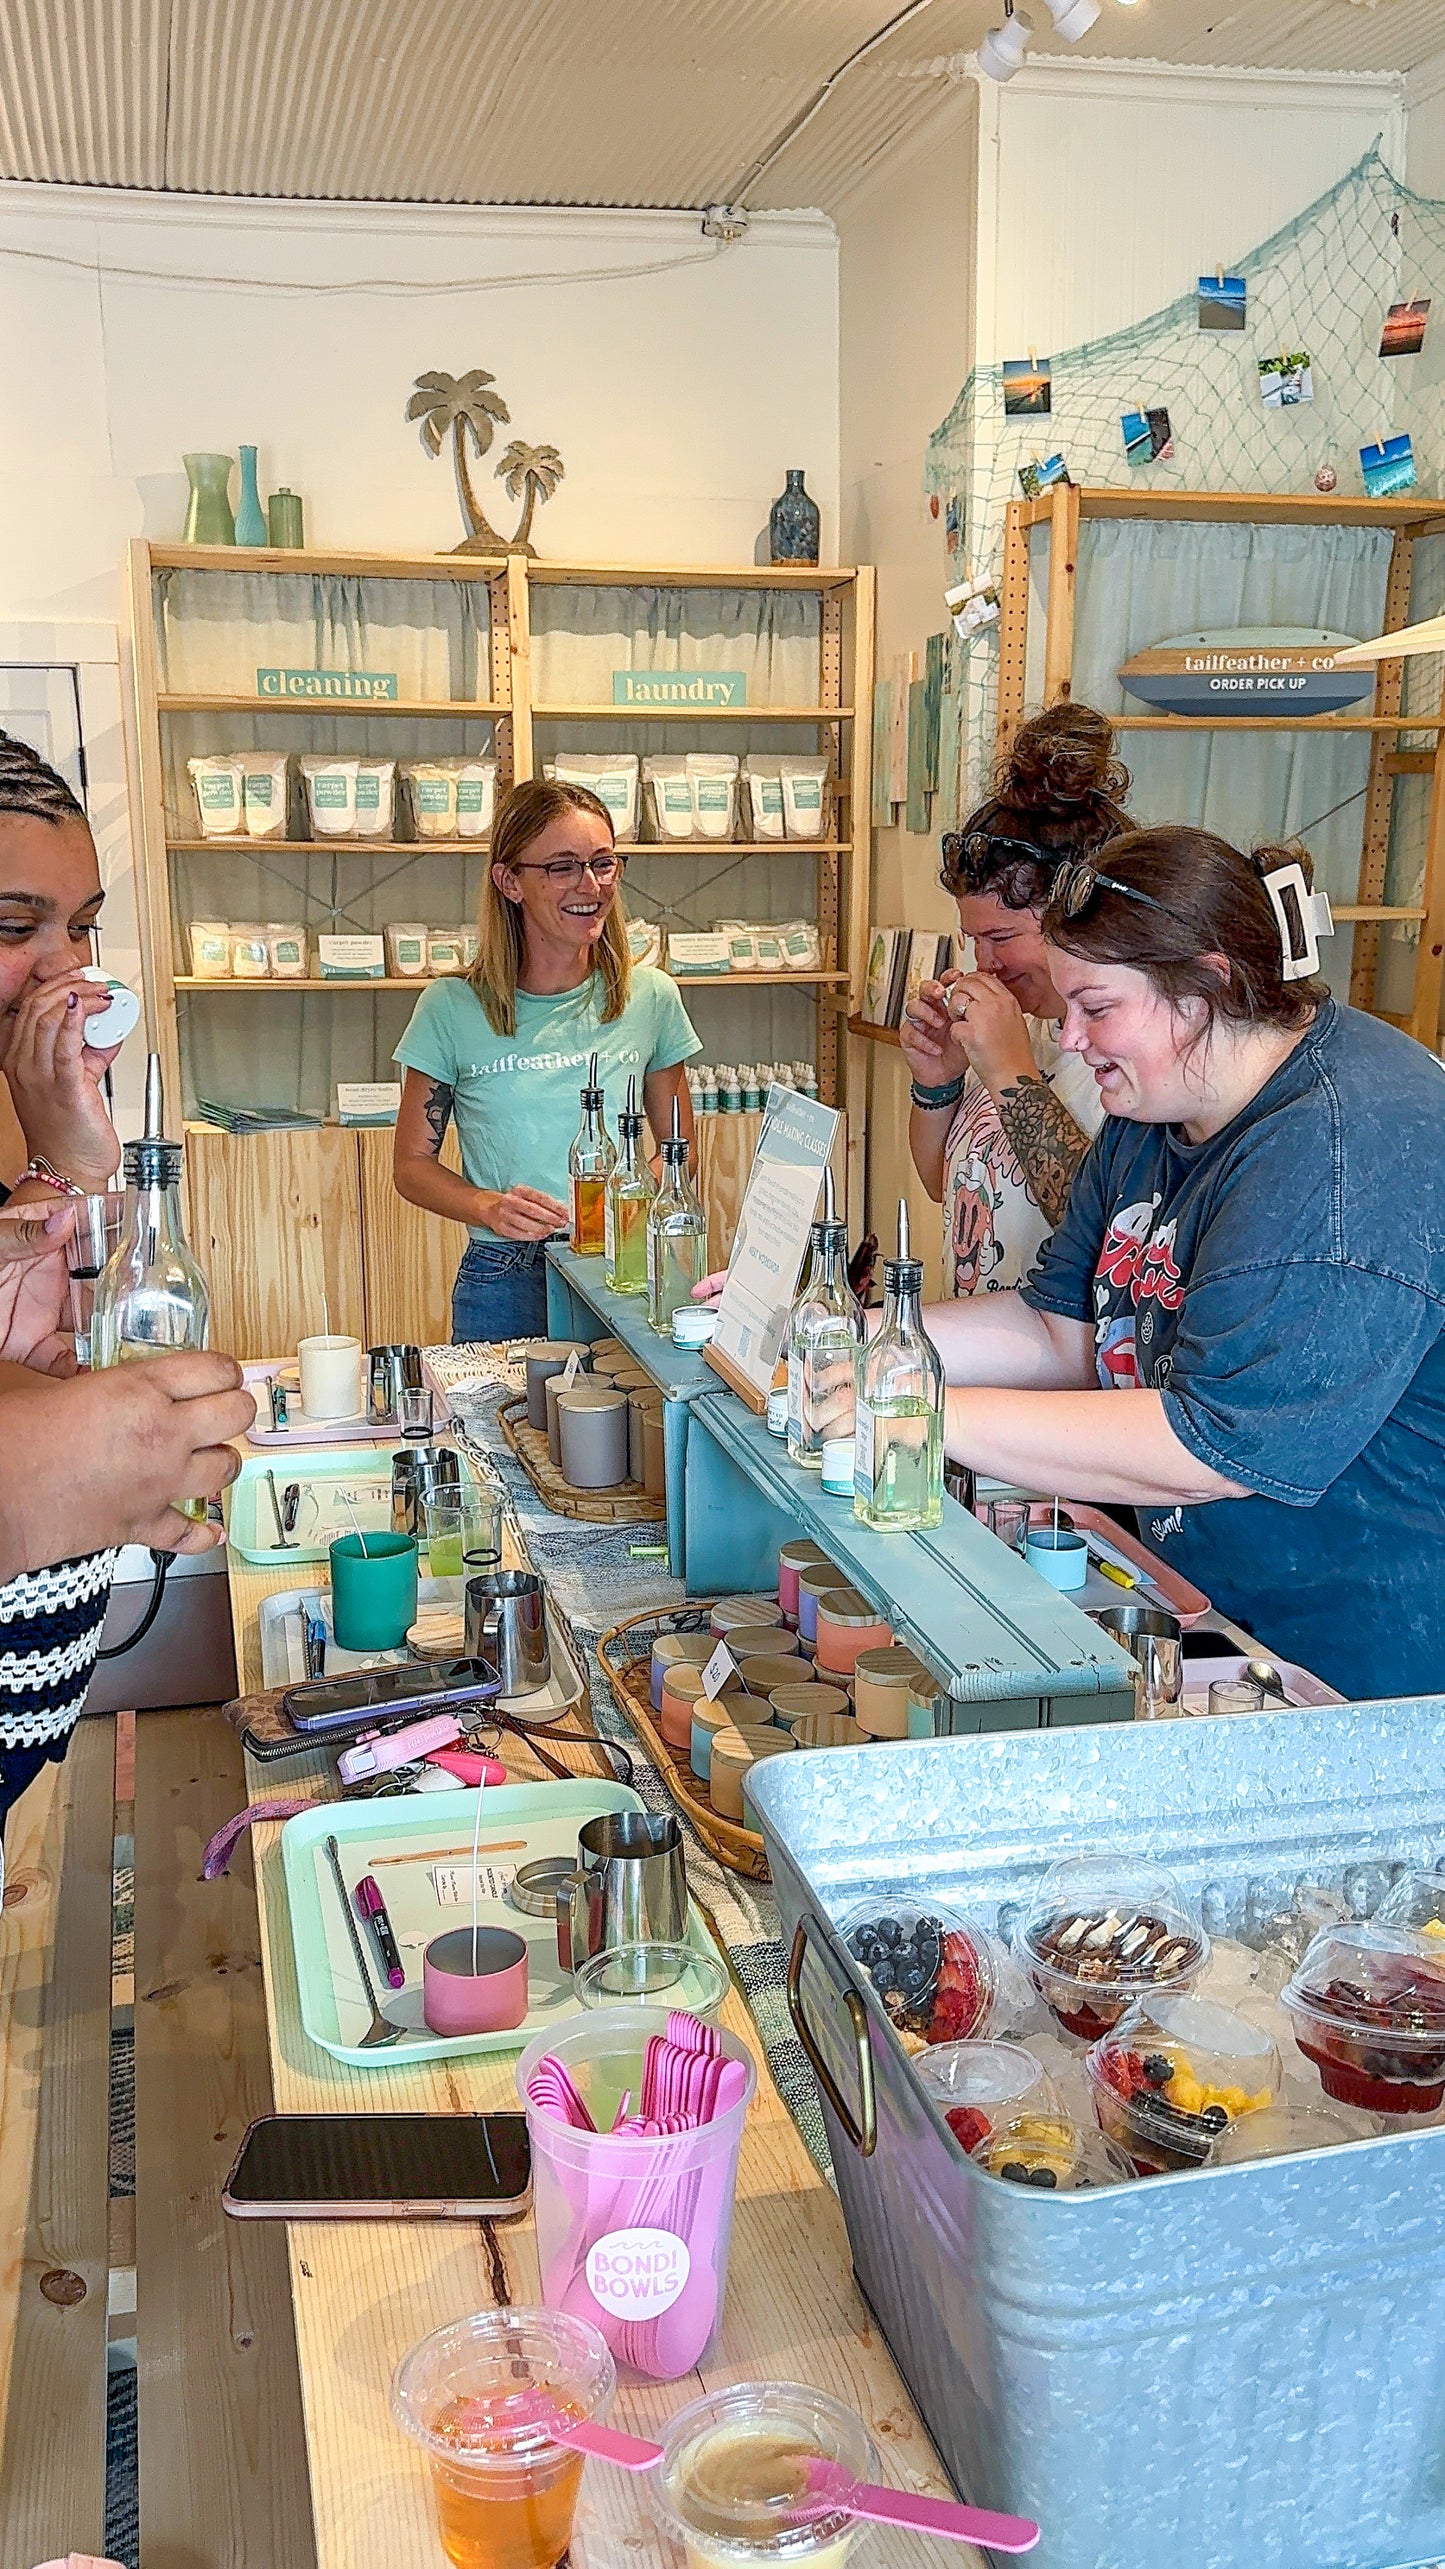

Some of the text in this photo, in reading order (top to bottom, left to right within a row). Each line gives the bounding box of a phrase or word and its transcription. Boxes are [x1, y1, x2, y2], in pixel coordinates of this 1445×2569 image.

[1185, 654, 1335, 671] tailfeather + co
[262, 670, 390, 700] cleaning
[625, 678, 736, 706] laundry
[1209, 677, 1307, 691] ORDER PICK UP
[618, 1050, 640, 1064] co
[804, 1133, 828, 1158] CLASSES
[594, 2249, 677, 2275] BONDI
[594, 2271, 679, 2298] BOWLS
